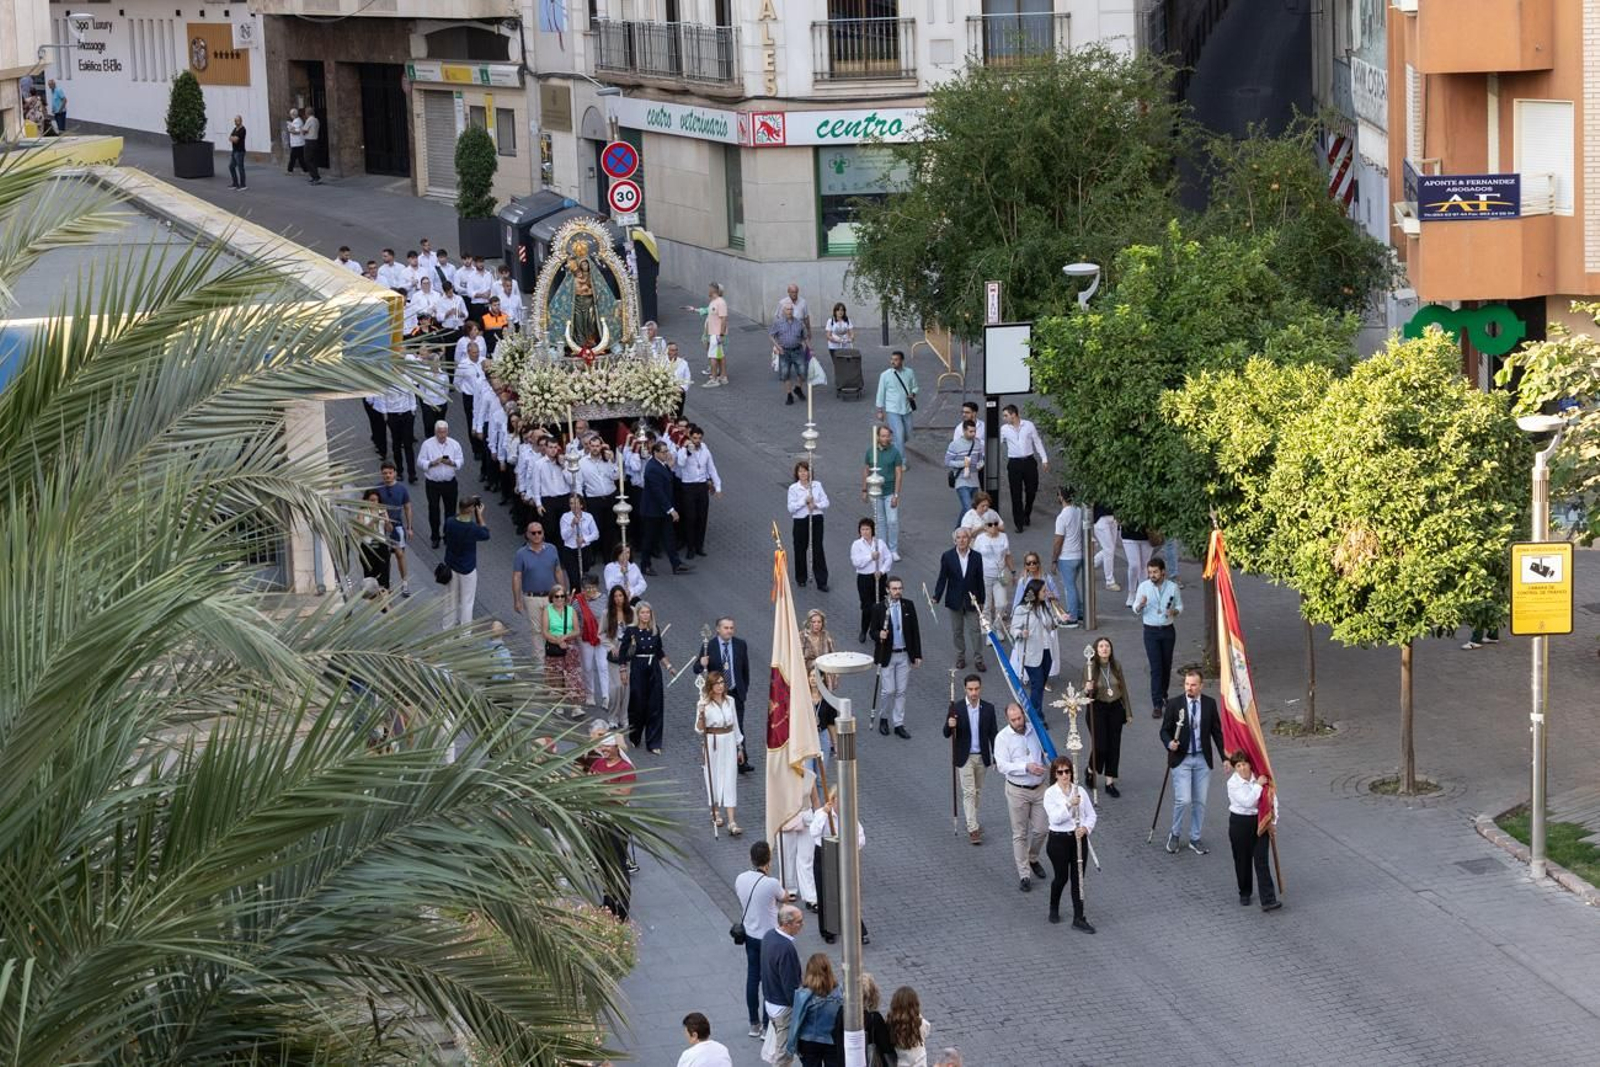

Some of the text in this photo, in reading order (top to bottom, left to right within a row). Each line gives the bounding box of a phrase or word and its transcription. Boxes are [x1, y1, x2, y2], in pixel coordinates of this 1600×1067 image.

[646, 106, 672, 130] centro
[679, 108, 729, 137] veterinario
[815, 112, 905, 139] centro
[1466, 178, 1516, 186] FERNANDEZ
[616, 190, 635, 203] 30
